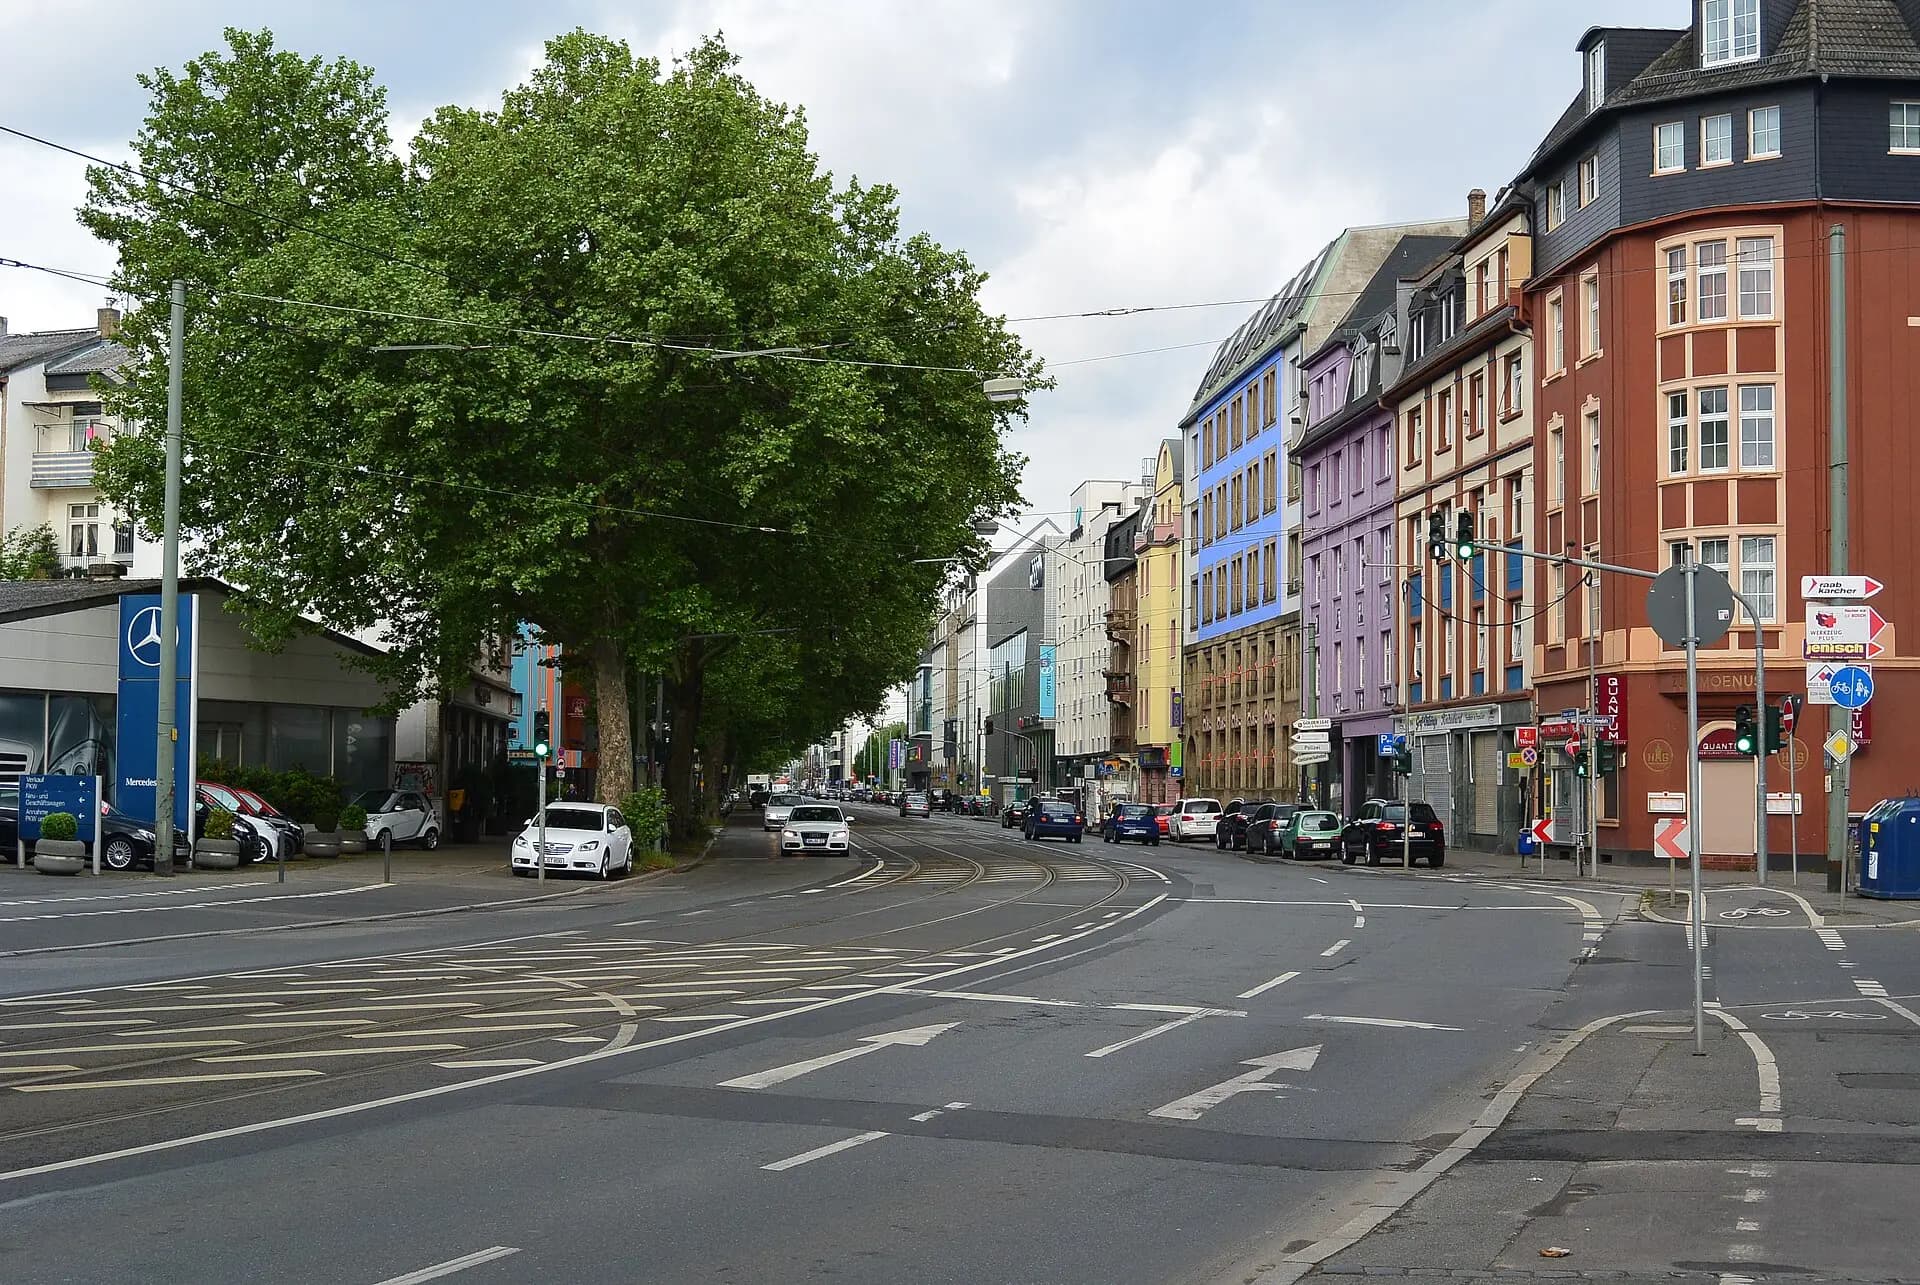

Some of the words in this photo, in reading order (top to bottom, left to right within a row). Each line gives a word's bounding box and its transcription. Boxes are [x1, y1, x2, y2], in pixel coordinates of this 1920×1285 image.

[1607, 677, 1619, 740] QUANTUM
[1380, 734, 1388, 744] P
[1702, 742, 1737, 750] QUANT
